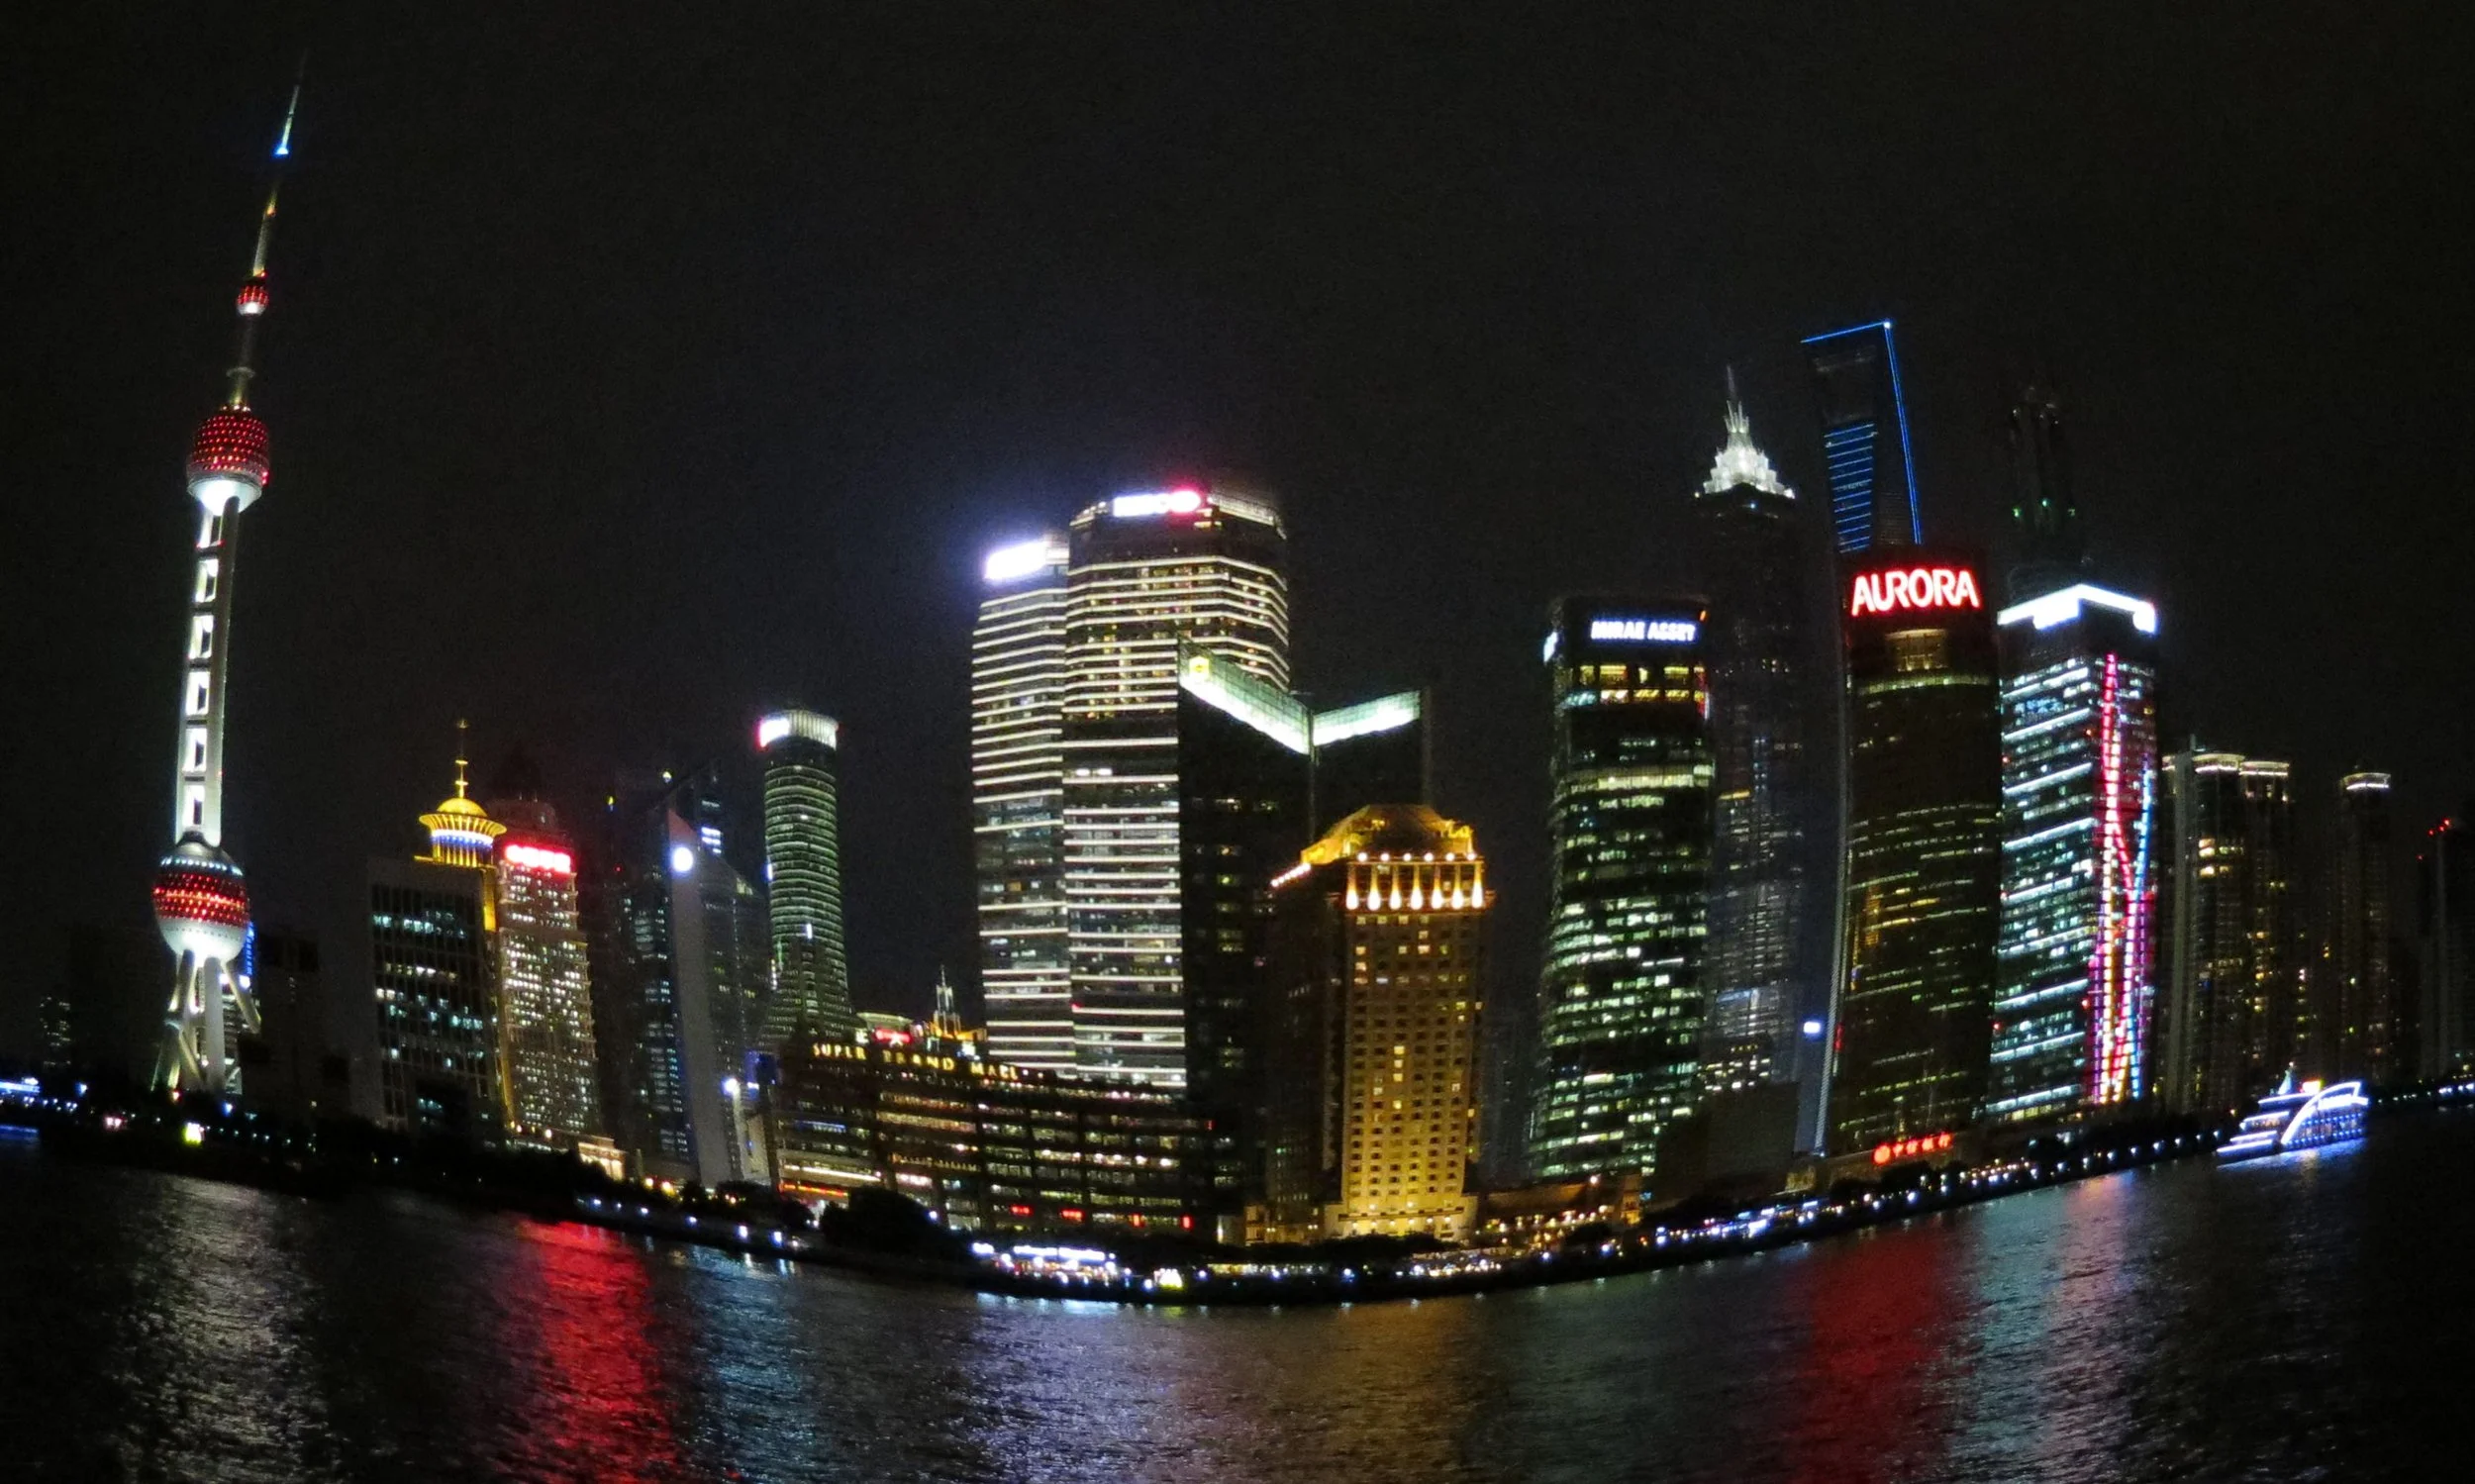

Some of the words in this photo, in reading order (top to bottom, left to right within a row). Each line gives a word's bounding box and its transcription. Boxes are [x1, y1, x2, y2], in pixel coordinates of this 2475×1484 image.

[1850, 567, 1980, 618] AURORA
[1646, 622, 1697, 642] ASSET
[812, 1042, 868, 1061] SUPER
[882, 1049, 956, 1071] BRAND
